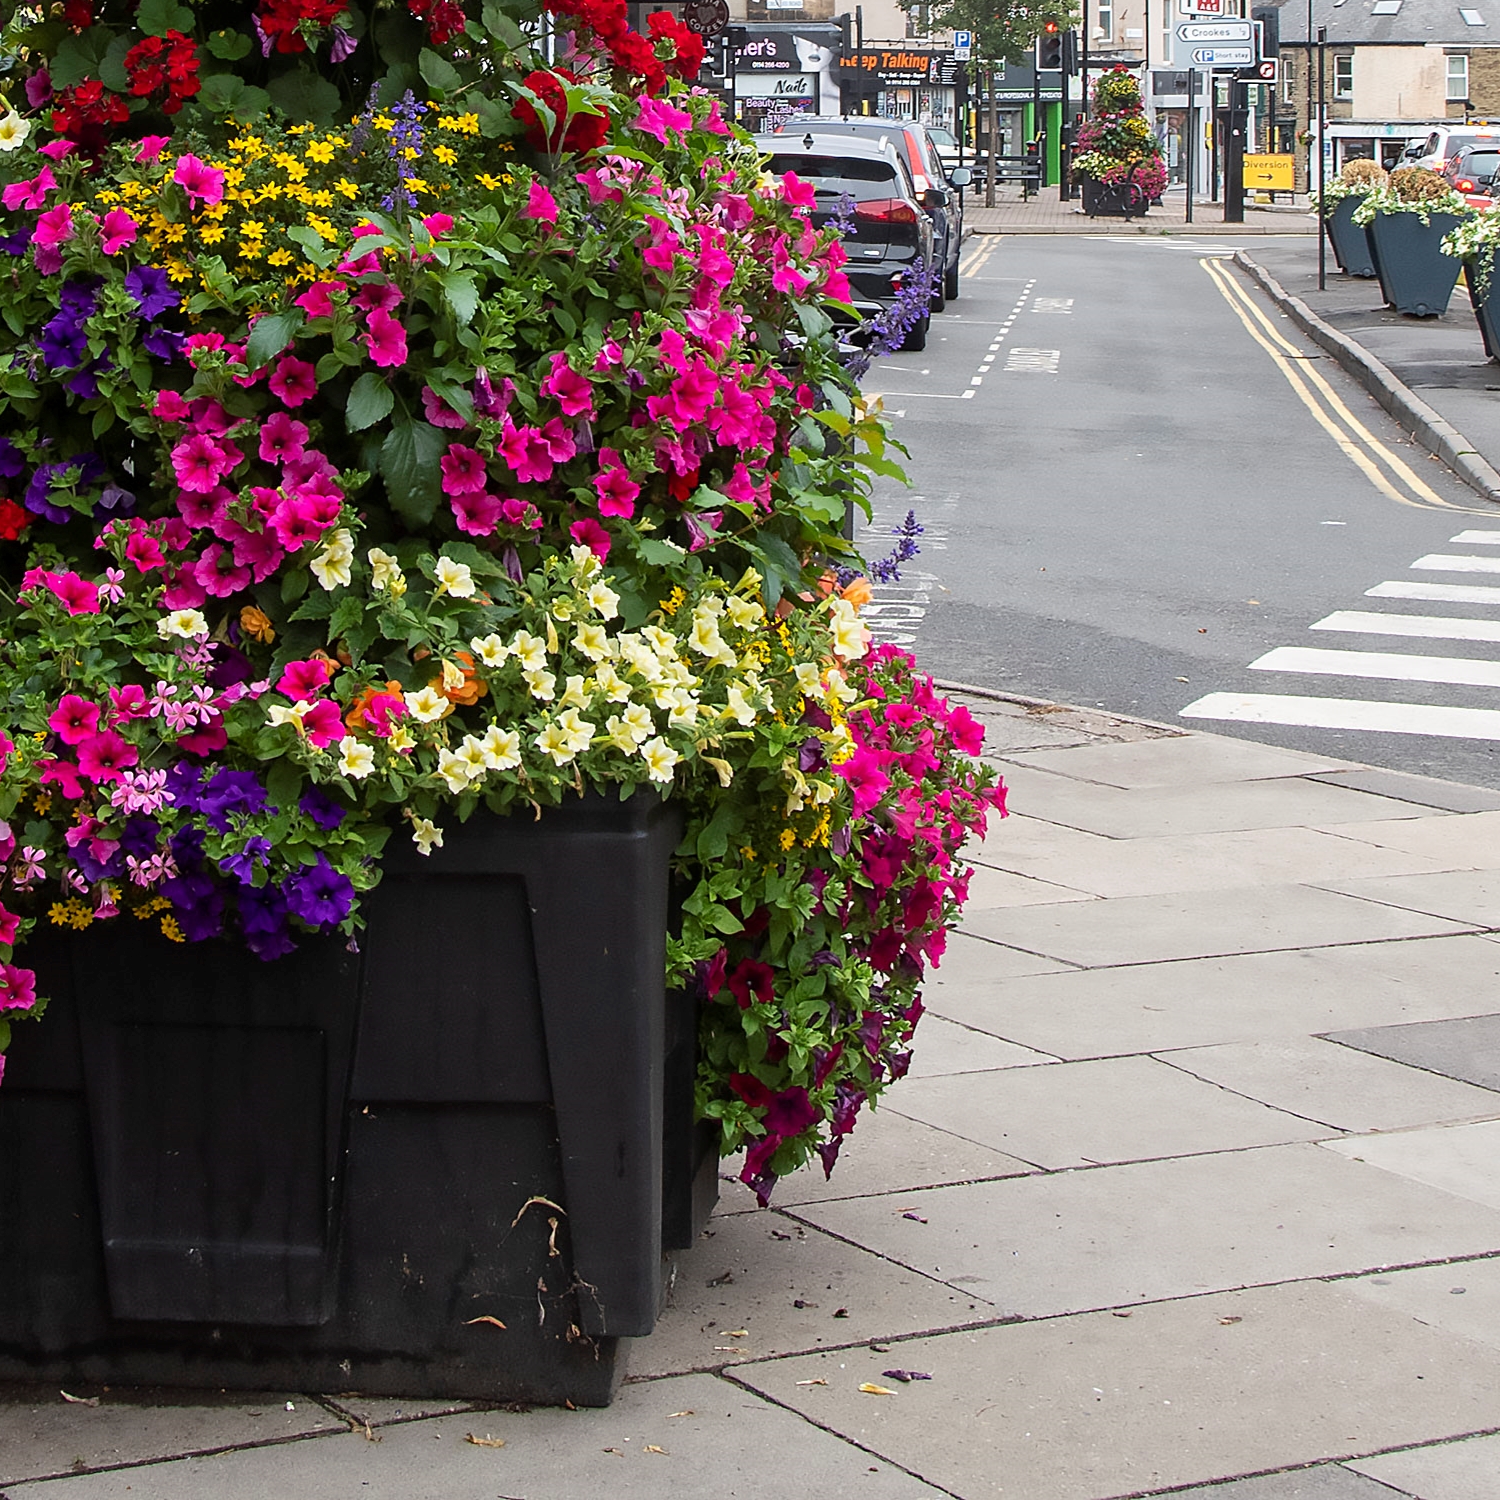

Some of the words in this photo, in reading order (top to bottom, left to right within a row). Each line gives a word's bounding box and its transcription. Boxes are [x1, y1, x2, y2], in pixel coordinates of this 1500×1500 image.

[1199, 3, 1218, 11] A&E
[688, 17, 724, 35] COFFEE
[1191, 27, 1231, 37] Crookes
[957, 33, 968, 45] P
[1204, 50, 1213, 61] P
[1215, 51, 1232, 59] Short
[1234, 51, 1249, 60] stay
[881, 52, 929, 72] Talking
[773, 77, 808, 94] Nails
[745, 98, 776, 110] Beauty
[774, 104, 804, 114] Lashes
[1243, 160, 1289, 170] Diversion
